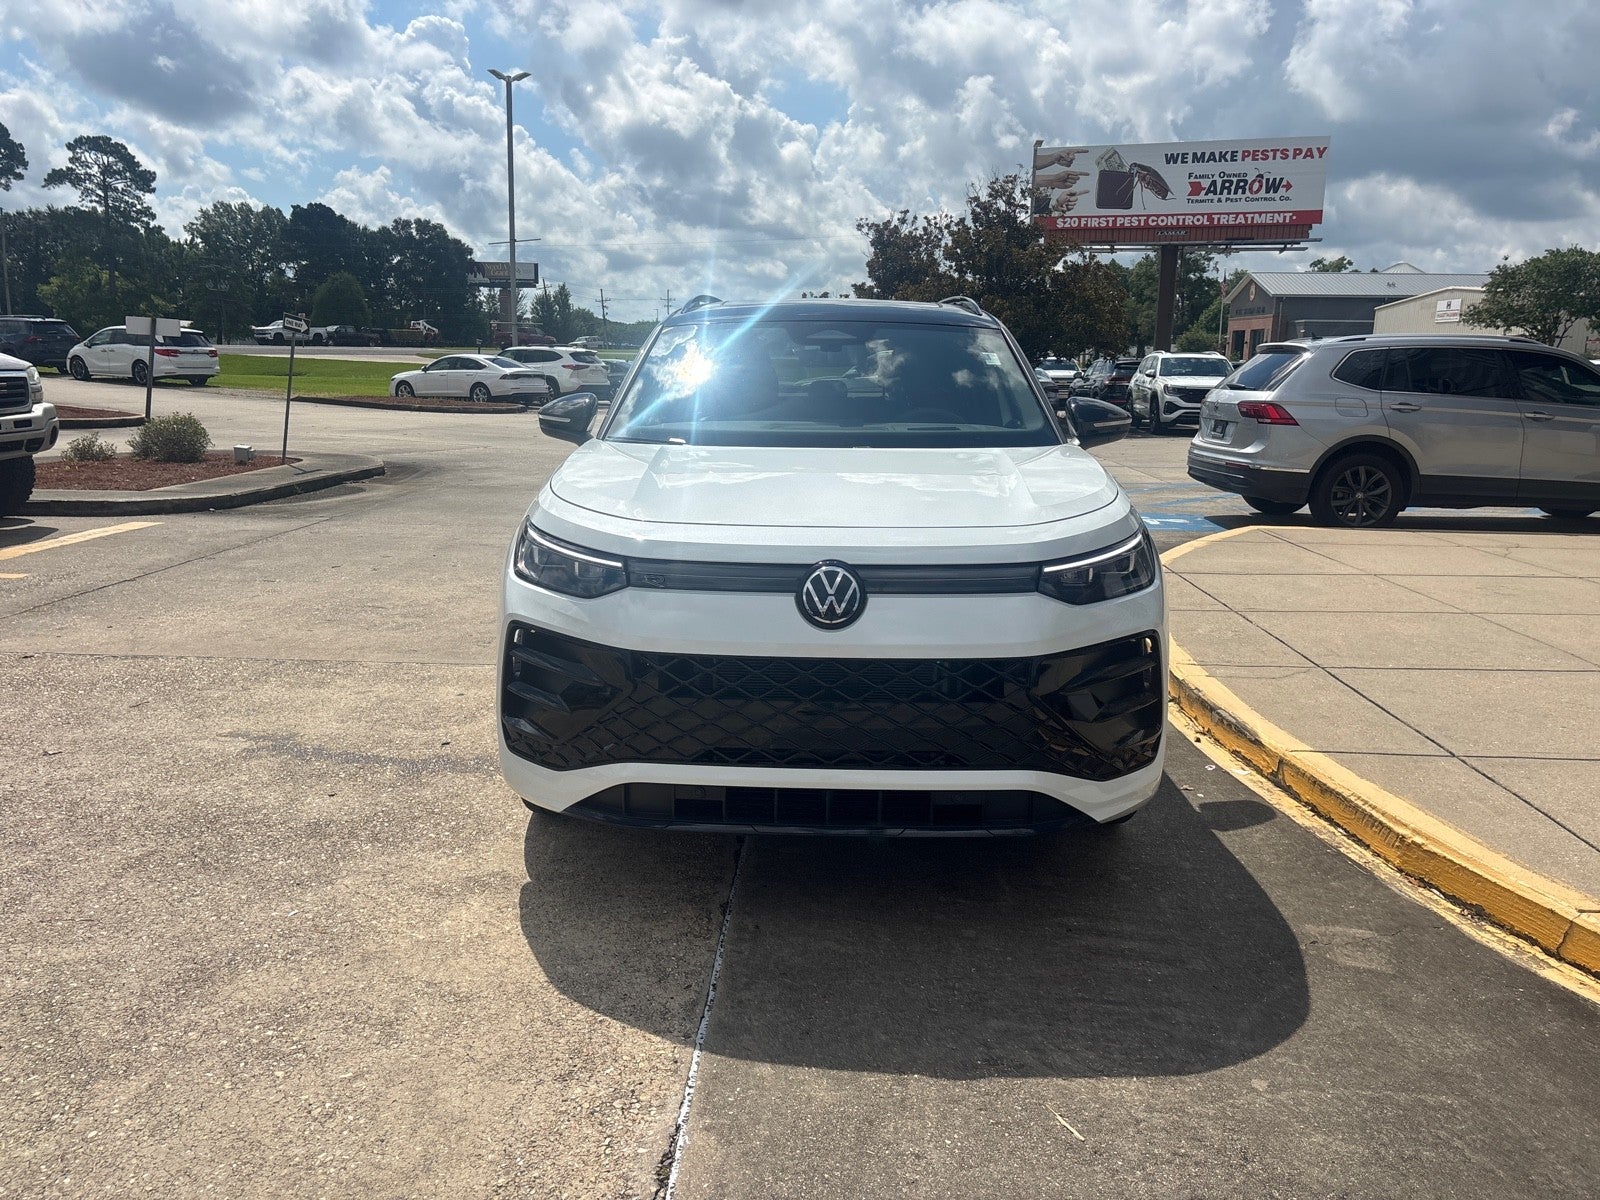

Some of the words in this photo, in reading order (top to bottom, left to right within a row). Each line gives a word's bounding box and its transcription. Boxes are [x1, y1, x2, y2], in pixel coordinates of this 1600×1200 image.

[1164, 152, 1189, 165] WE
[1191, 150, 1239, 164] MAKE
[1241, 148, 1290, 162] PESTS
[1292, 146, 1328, 160] PAY
[1204, 176, 1285, 196] ARROW
[1056, 217, 1079, 228] $20
[1080, 217, 1115, 228] FIRST
[1116, 216, 1147, 227] PEST
[1148, 214, 1210, 226] CONTROL
